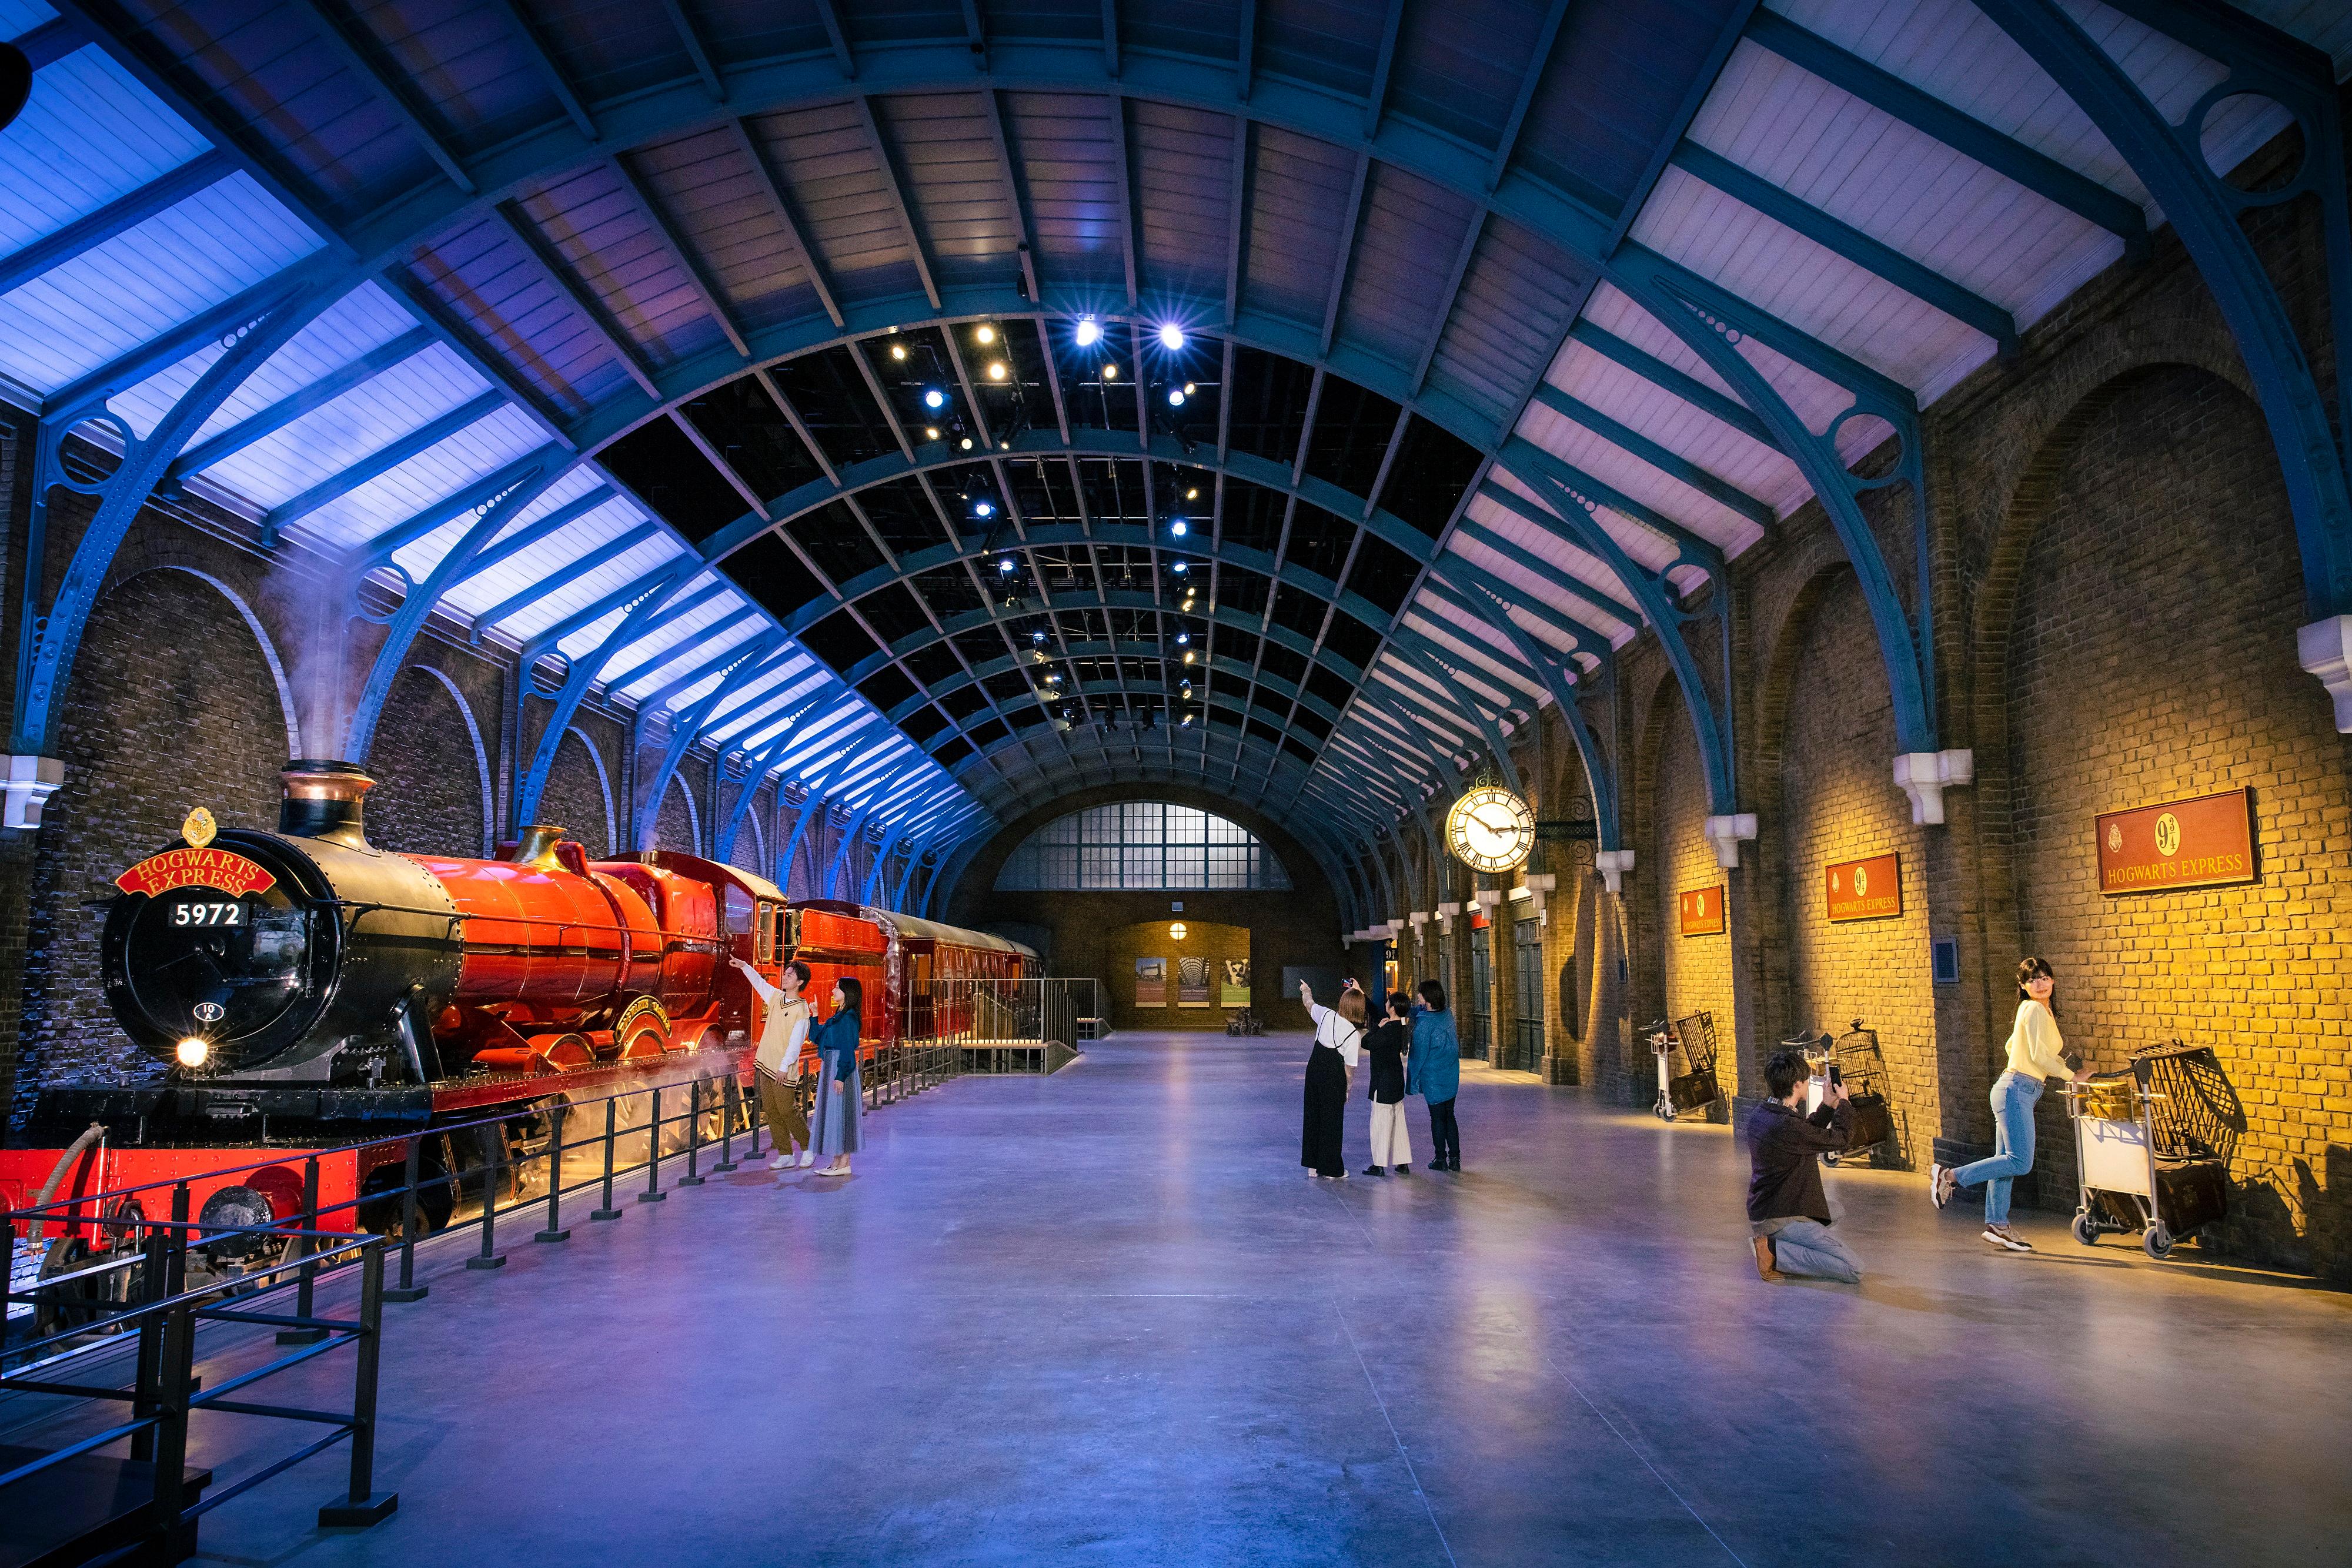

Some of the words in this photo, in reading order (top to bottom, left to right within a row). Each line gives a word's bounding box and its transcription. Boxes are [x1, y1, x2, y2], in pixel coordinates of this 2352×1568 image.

[135, 850, 260, 881] HOGWARTS
[2109, 861, 2176, 884] HOGWARTS
[2182, 854, 2243, 876] EXPRESS
[148, 868, 246, 895] EXPRESS
[176, 904, 240, 925] 5972
[1832, 900, 1865, 914] HOGWARTS
[1867, 897, 1895, 911] EXPRESS
[1705, 918, 1721, 928] EXPRESS
[203, 1004, 215, 1013] 10
